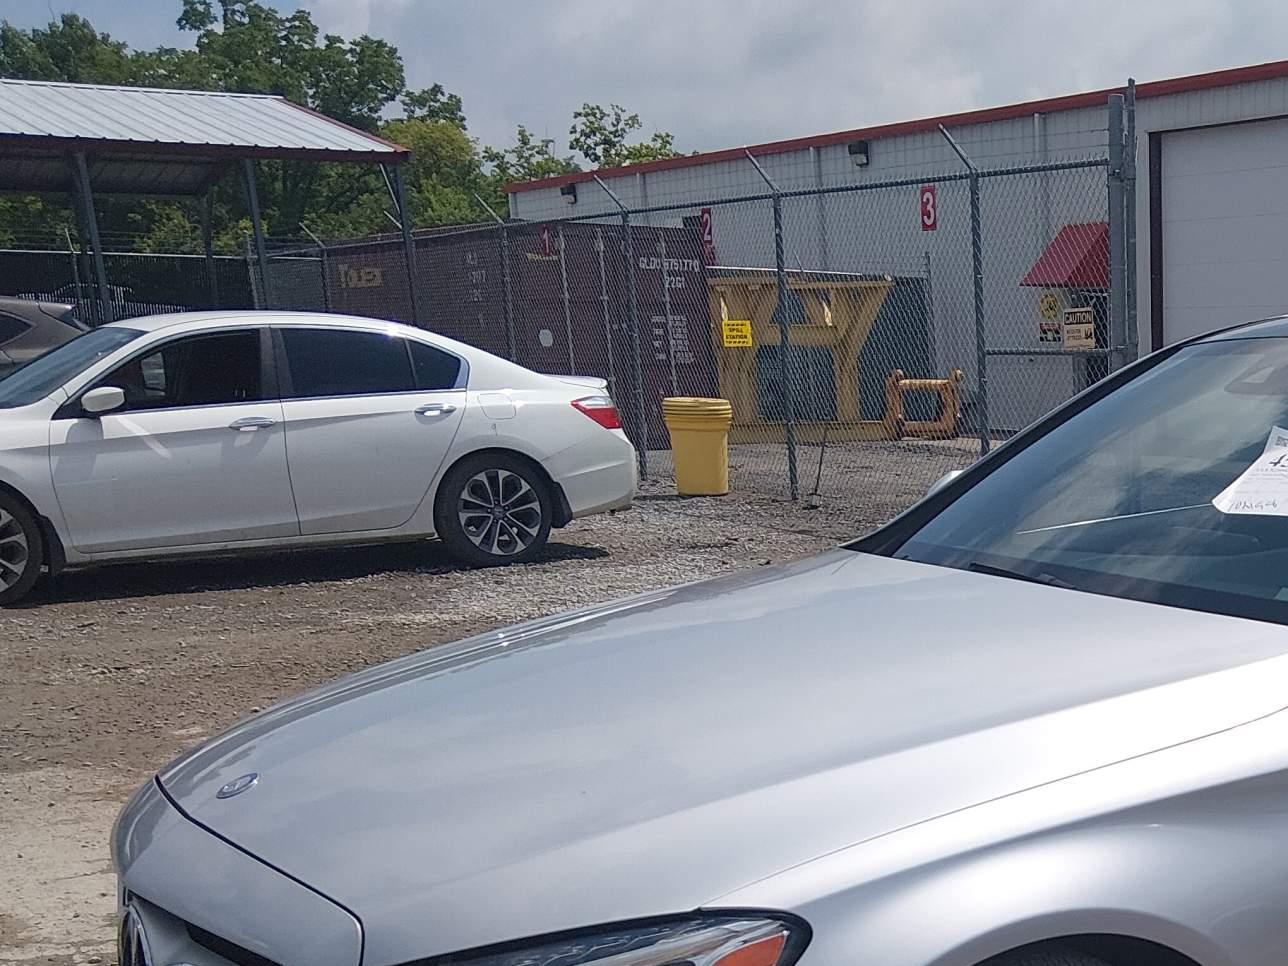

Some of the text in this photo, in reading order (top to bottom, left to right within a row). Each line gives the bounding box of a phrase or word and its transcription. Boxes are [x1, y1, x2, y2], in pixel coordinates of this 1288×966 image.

[922, 191, 935, 225] 3
[703, 213, 711, 241] 2
[1065, 312, 1091, 324] CAUTION
